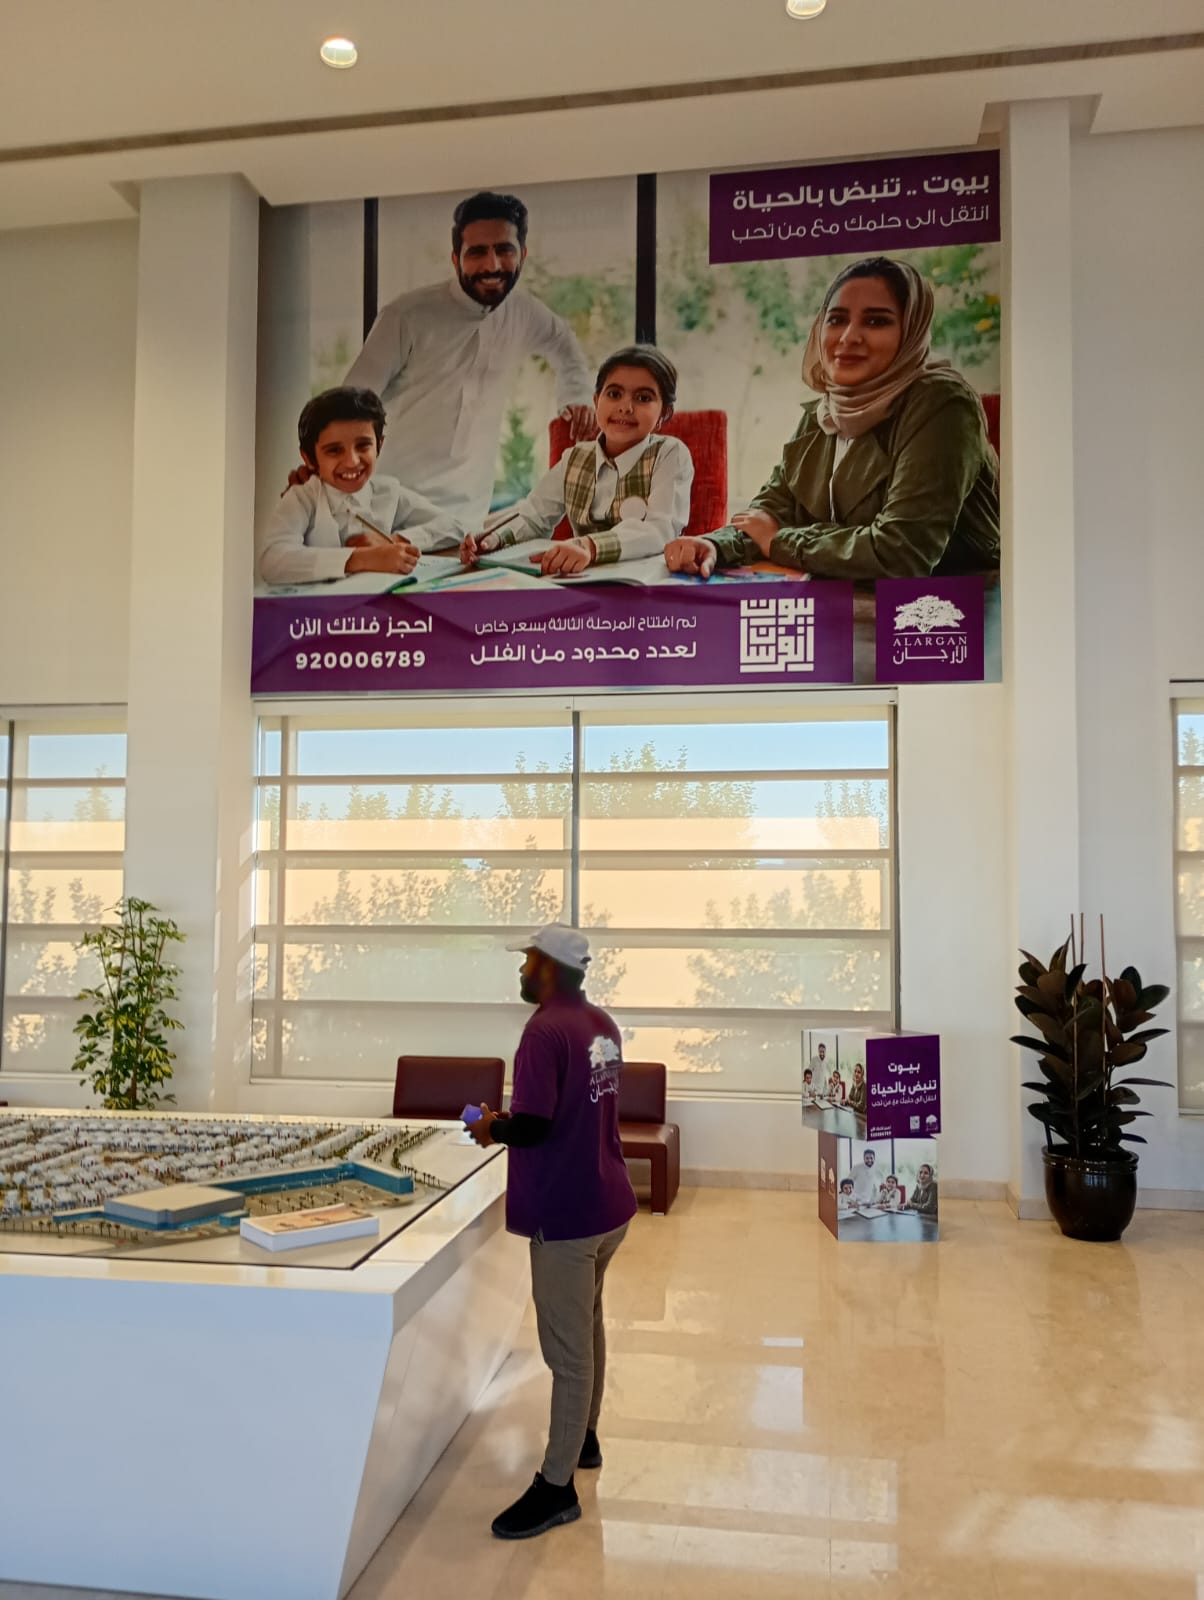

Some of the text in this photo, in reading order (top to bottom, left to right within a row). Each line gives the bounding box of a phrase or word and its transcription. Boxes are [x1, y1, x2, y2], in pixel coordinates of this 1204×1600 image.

[829, 177, 901, 207] تنبض
[924, 175, 989, 197] بيوت
[733, 186, 824, 213] بالحياة
[844, 213, 902, 232] حلمك
[940, 205, 989, 227] انتقل
[731, 223, 774, 244] تحب
[778, 222, 807, 240] من
[811, 217, 840, 238] مع
[326, 616, 380, 636] فلتك
[386, 615, 433, 638] احجز
[475, 615, 697, 636] تم افتتاح المرحلة الثالثة بسعر خاص
[893, 636, 967, 646] ALARGAN
[295, 650, 426, 669] 920006789
[470, 641, 697, 665] لعدد محدود من الفلل
[888, 1063, 920, 1075] بيوت
[871, 1080, 937, 1097] تنبض بالحياة
